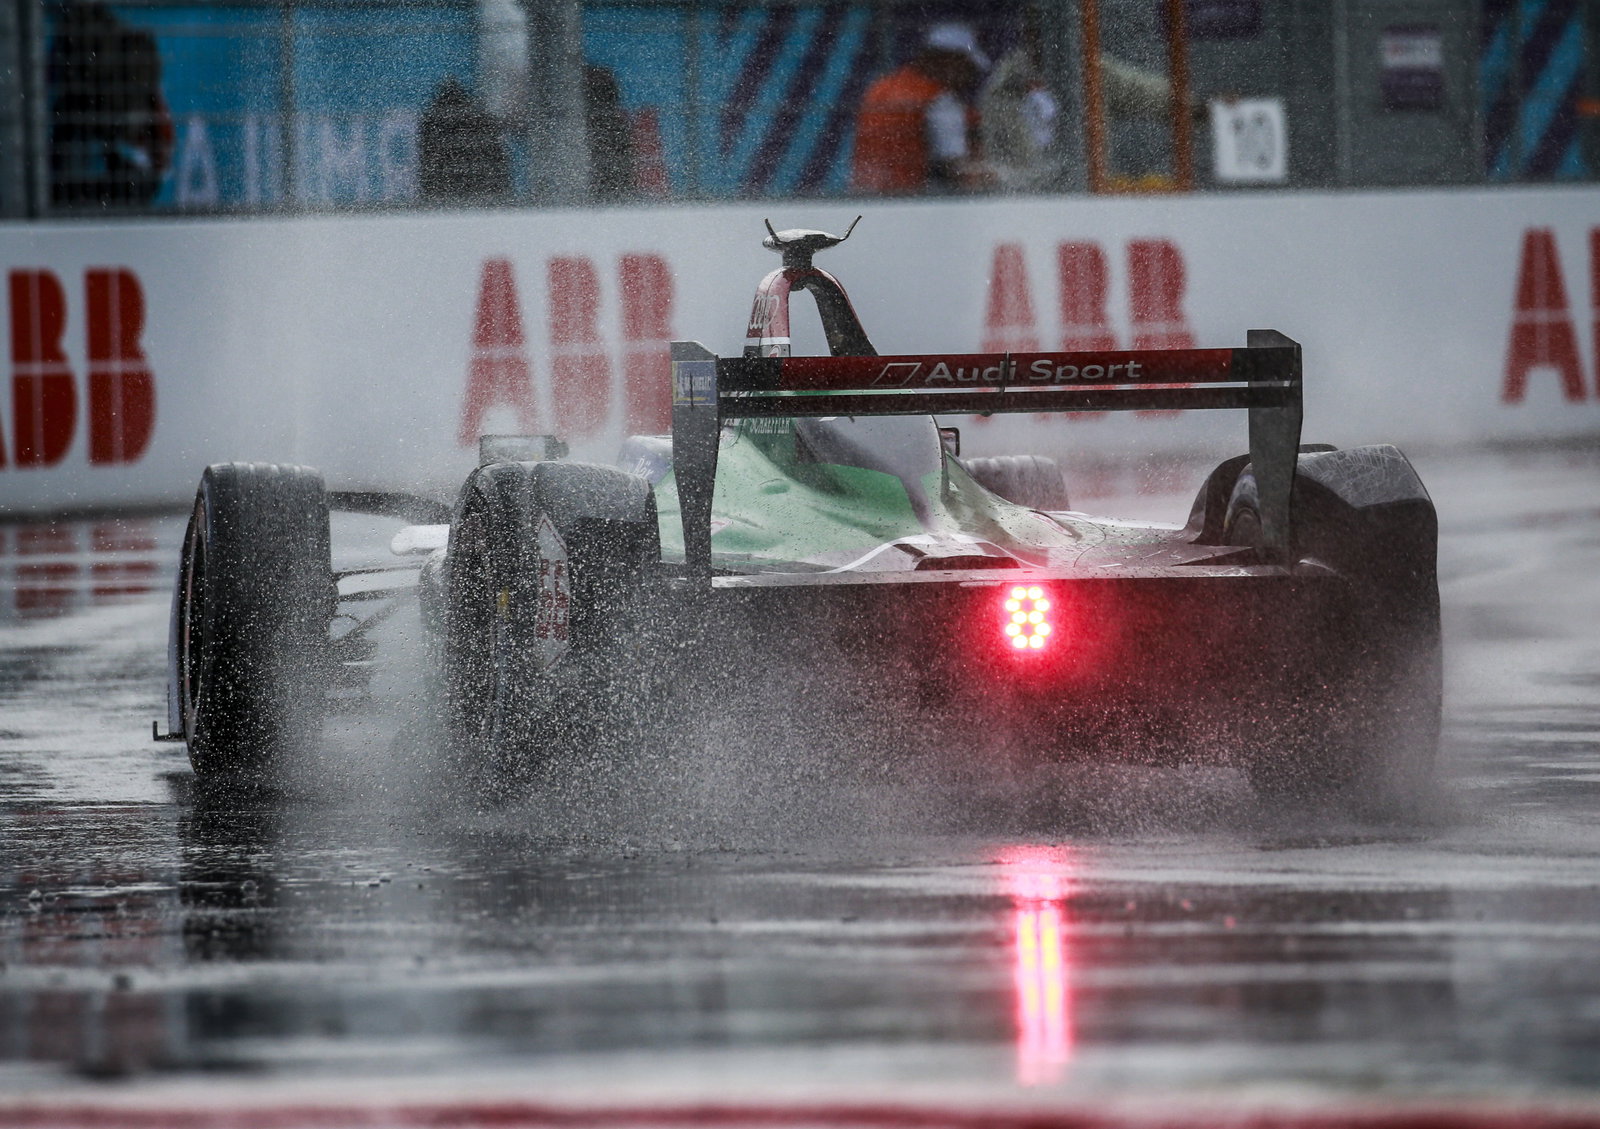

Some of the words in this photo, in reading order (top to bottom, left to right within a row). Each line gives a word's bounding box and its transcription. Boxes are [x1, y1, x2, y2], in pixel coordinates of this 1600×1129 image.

[0, 266, 156, 469] BB
[458, 254, 675, 447] ABB
[924, 361, 1017, 383] Audi
[1029, 359, 1143, 384] Sport
[972, 237, 1195, 424] ABB
[1502, 226, 1600, 404] A
